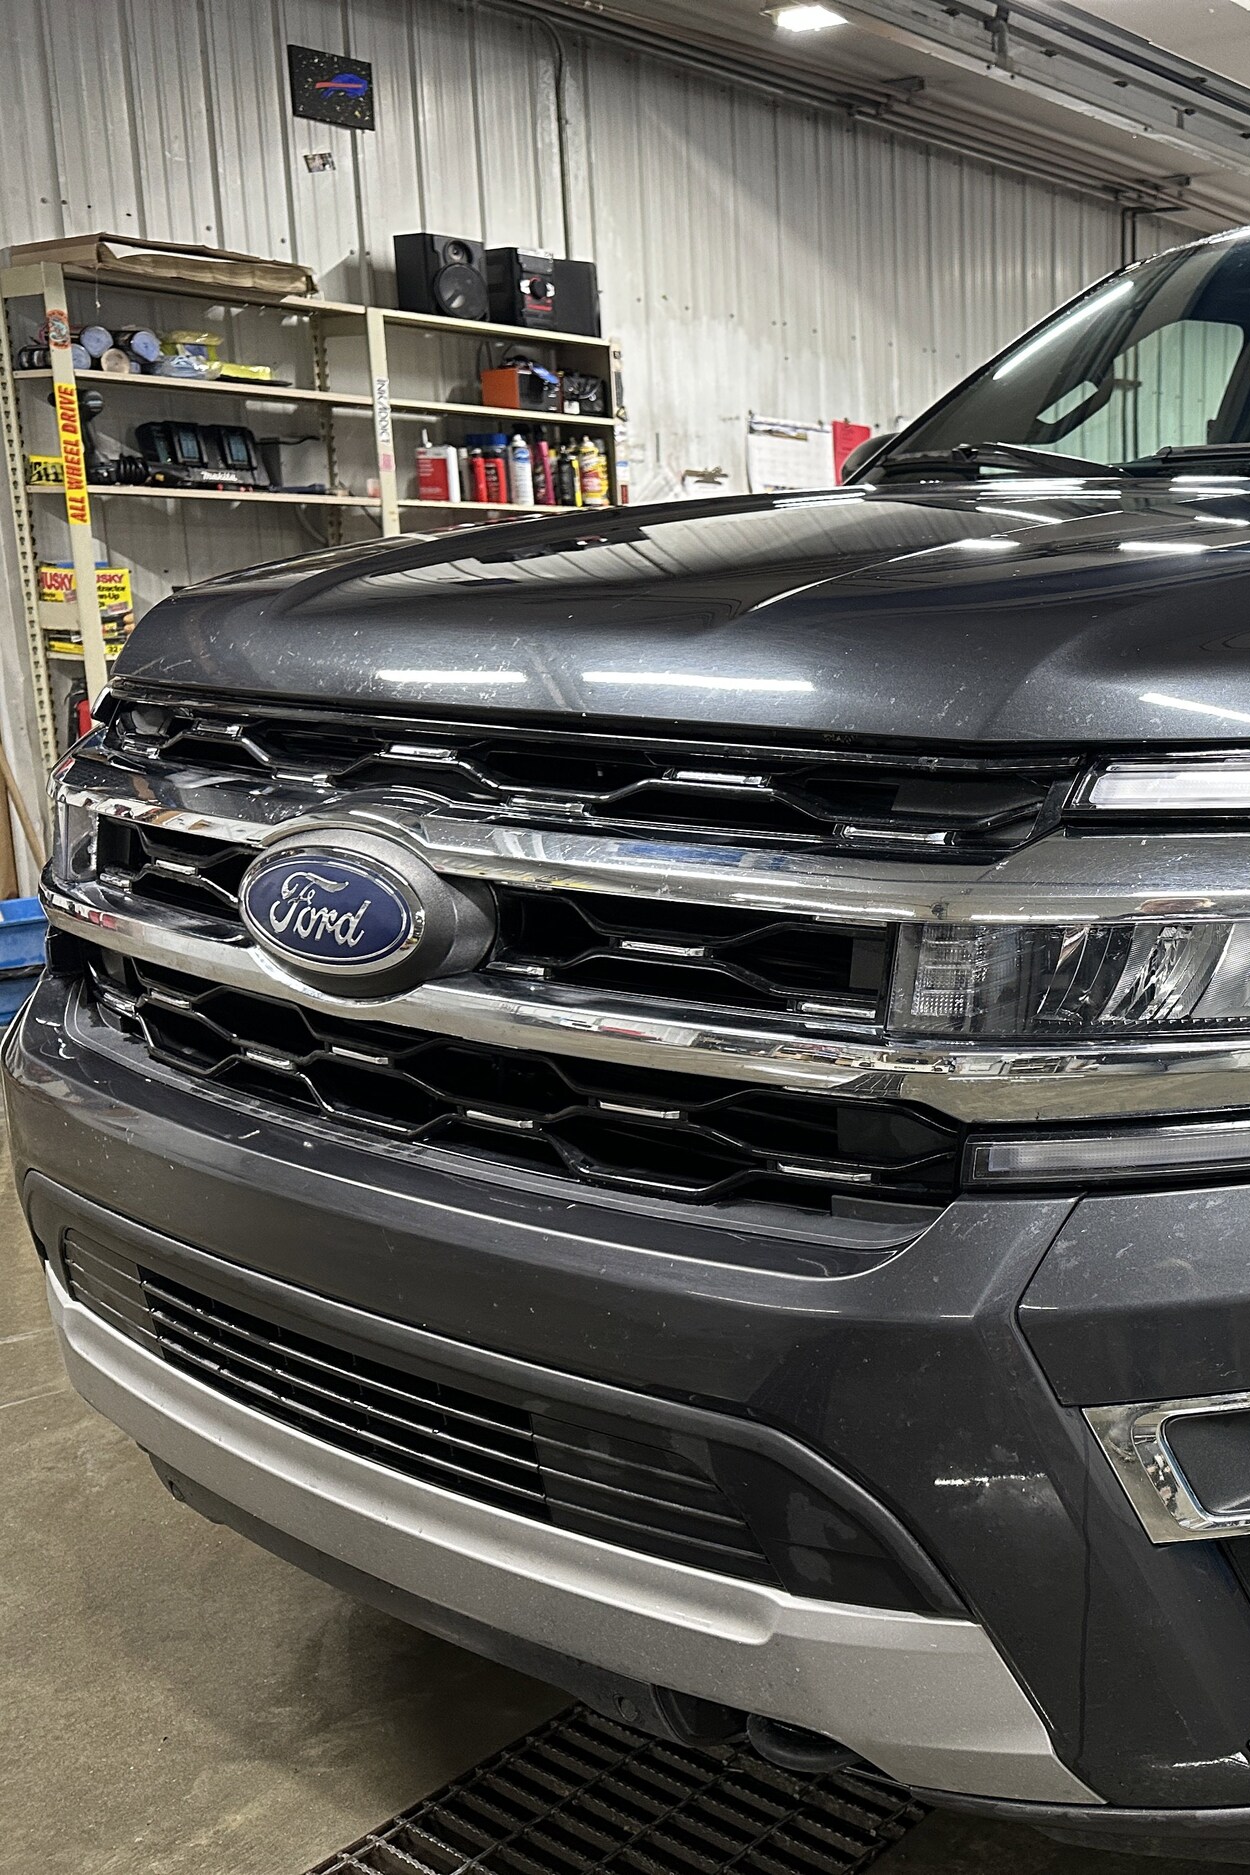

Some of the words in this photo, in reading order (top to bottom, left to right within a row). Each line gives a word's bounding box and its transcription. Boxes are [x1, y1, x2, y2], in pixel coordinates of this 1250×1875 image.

[58, 385, 79, 435] DRIVE
[63, 439, 84, 490] WHEEL
[68, 496, 87, 523] ALL
[269, 871, 372, 948] Ford
